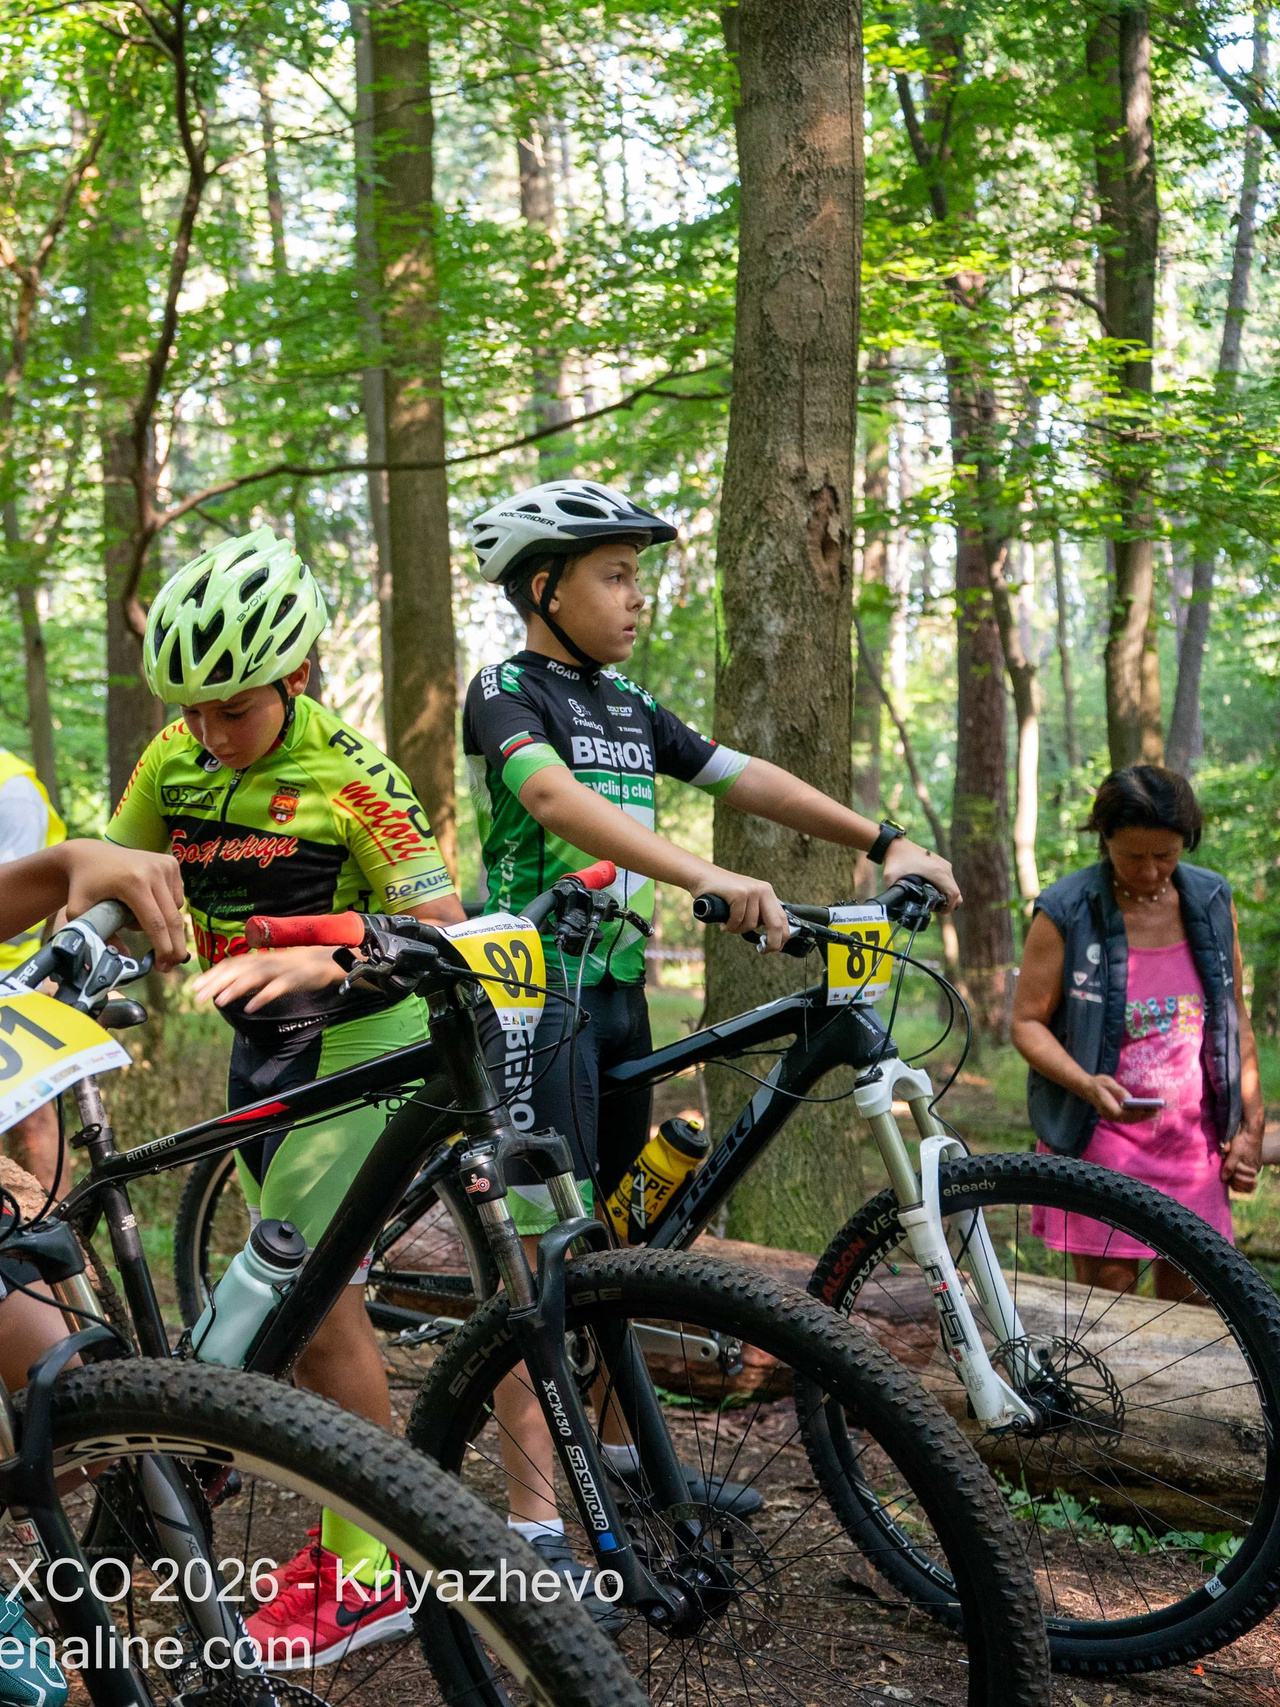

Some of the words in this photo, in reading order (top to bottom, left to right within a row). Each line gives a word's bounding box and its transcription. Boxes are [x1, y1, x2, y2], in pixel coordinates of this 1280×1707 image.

[499, 511, 556, 527] ROCKRIDER
[547, 660, 580, 682] ROAD
[570, 735, 654, 773] BEROE
[631, 782, 653, 800] club
[483, 939, 539, 999] 92
[846, 930, 881, 980] 87
[1125, 994, 1201, 1038] OVE
[125, 1136, 177, 1164] ANTERO
[818, 1233, 867, 1304] ALSON
[541, 1379, 572, 1438] XCM30
